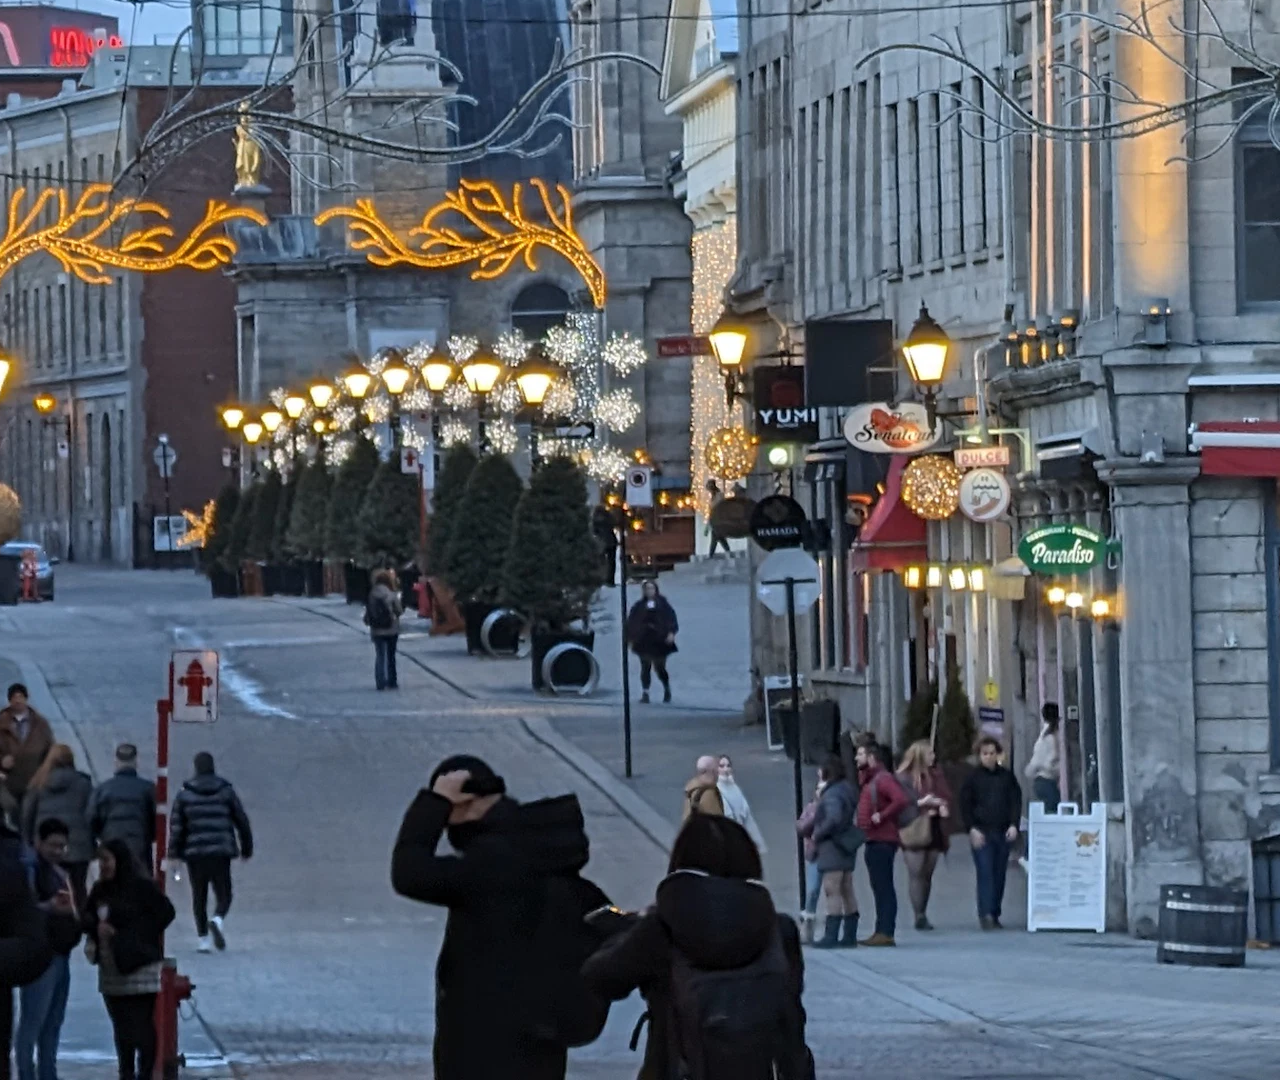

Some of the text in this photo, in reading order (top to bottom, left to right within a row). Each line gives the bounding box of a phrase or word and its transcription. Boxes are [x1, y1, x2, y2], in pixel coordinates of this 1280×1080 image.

[759, 408, 817, 425] YUMI
[961, 451, 1003, 464] DULCE
[1031, 538, 1095, 564] Paradiso
